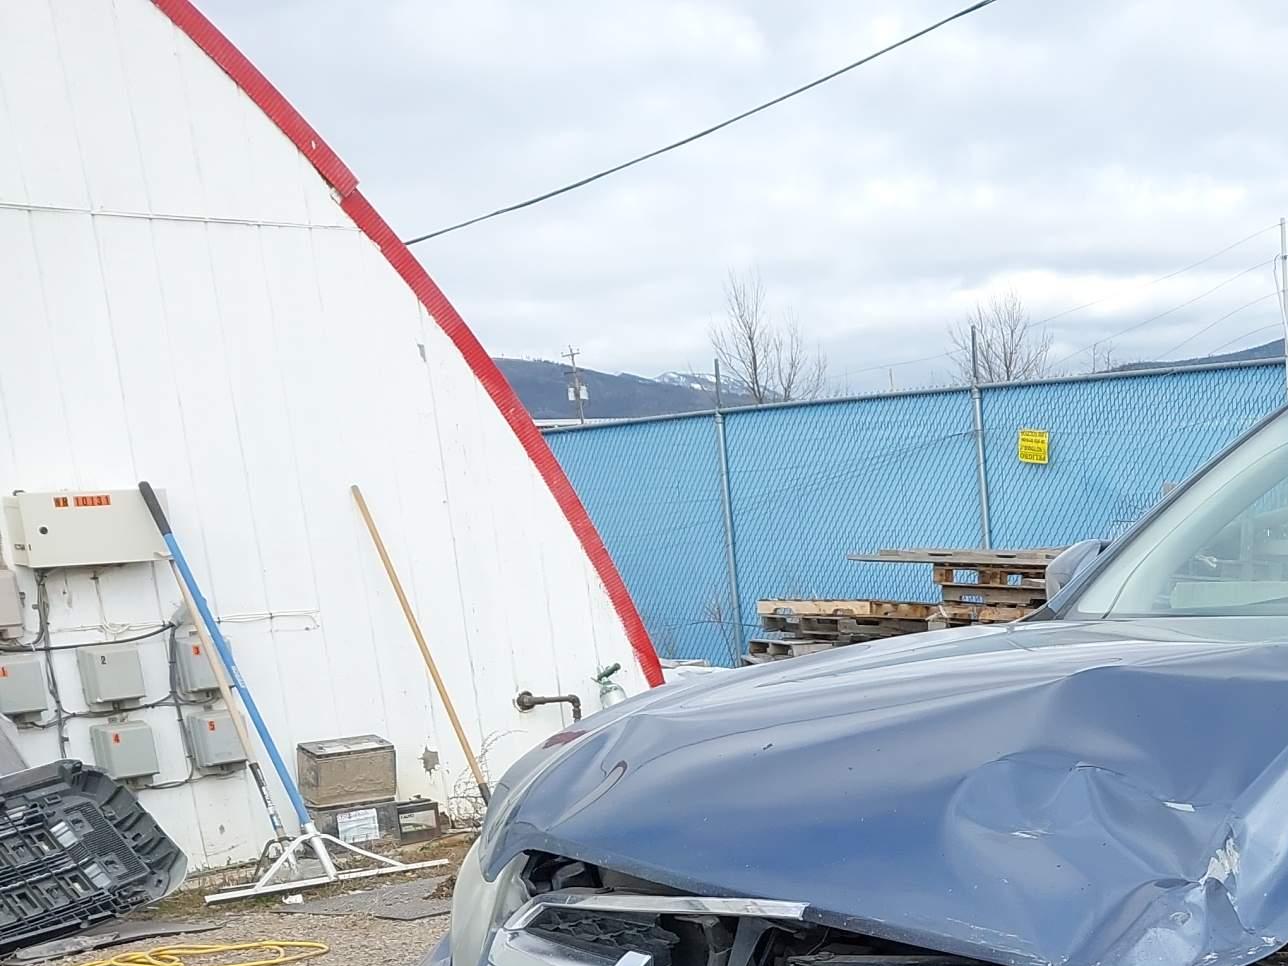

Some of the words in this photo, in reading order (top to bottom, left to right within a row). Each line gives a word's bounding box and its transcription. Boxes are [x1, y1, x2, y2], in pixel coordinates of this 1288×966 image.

[101, 655, 107, 664] 2
[209, 721, 215, 730] 5
[113, 734, 120, 743] 4
